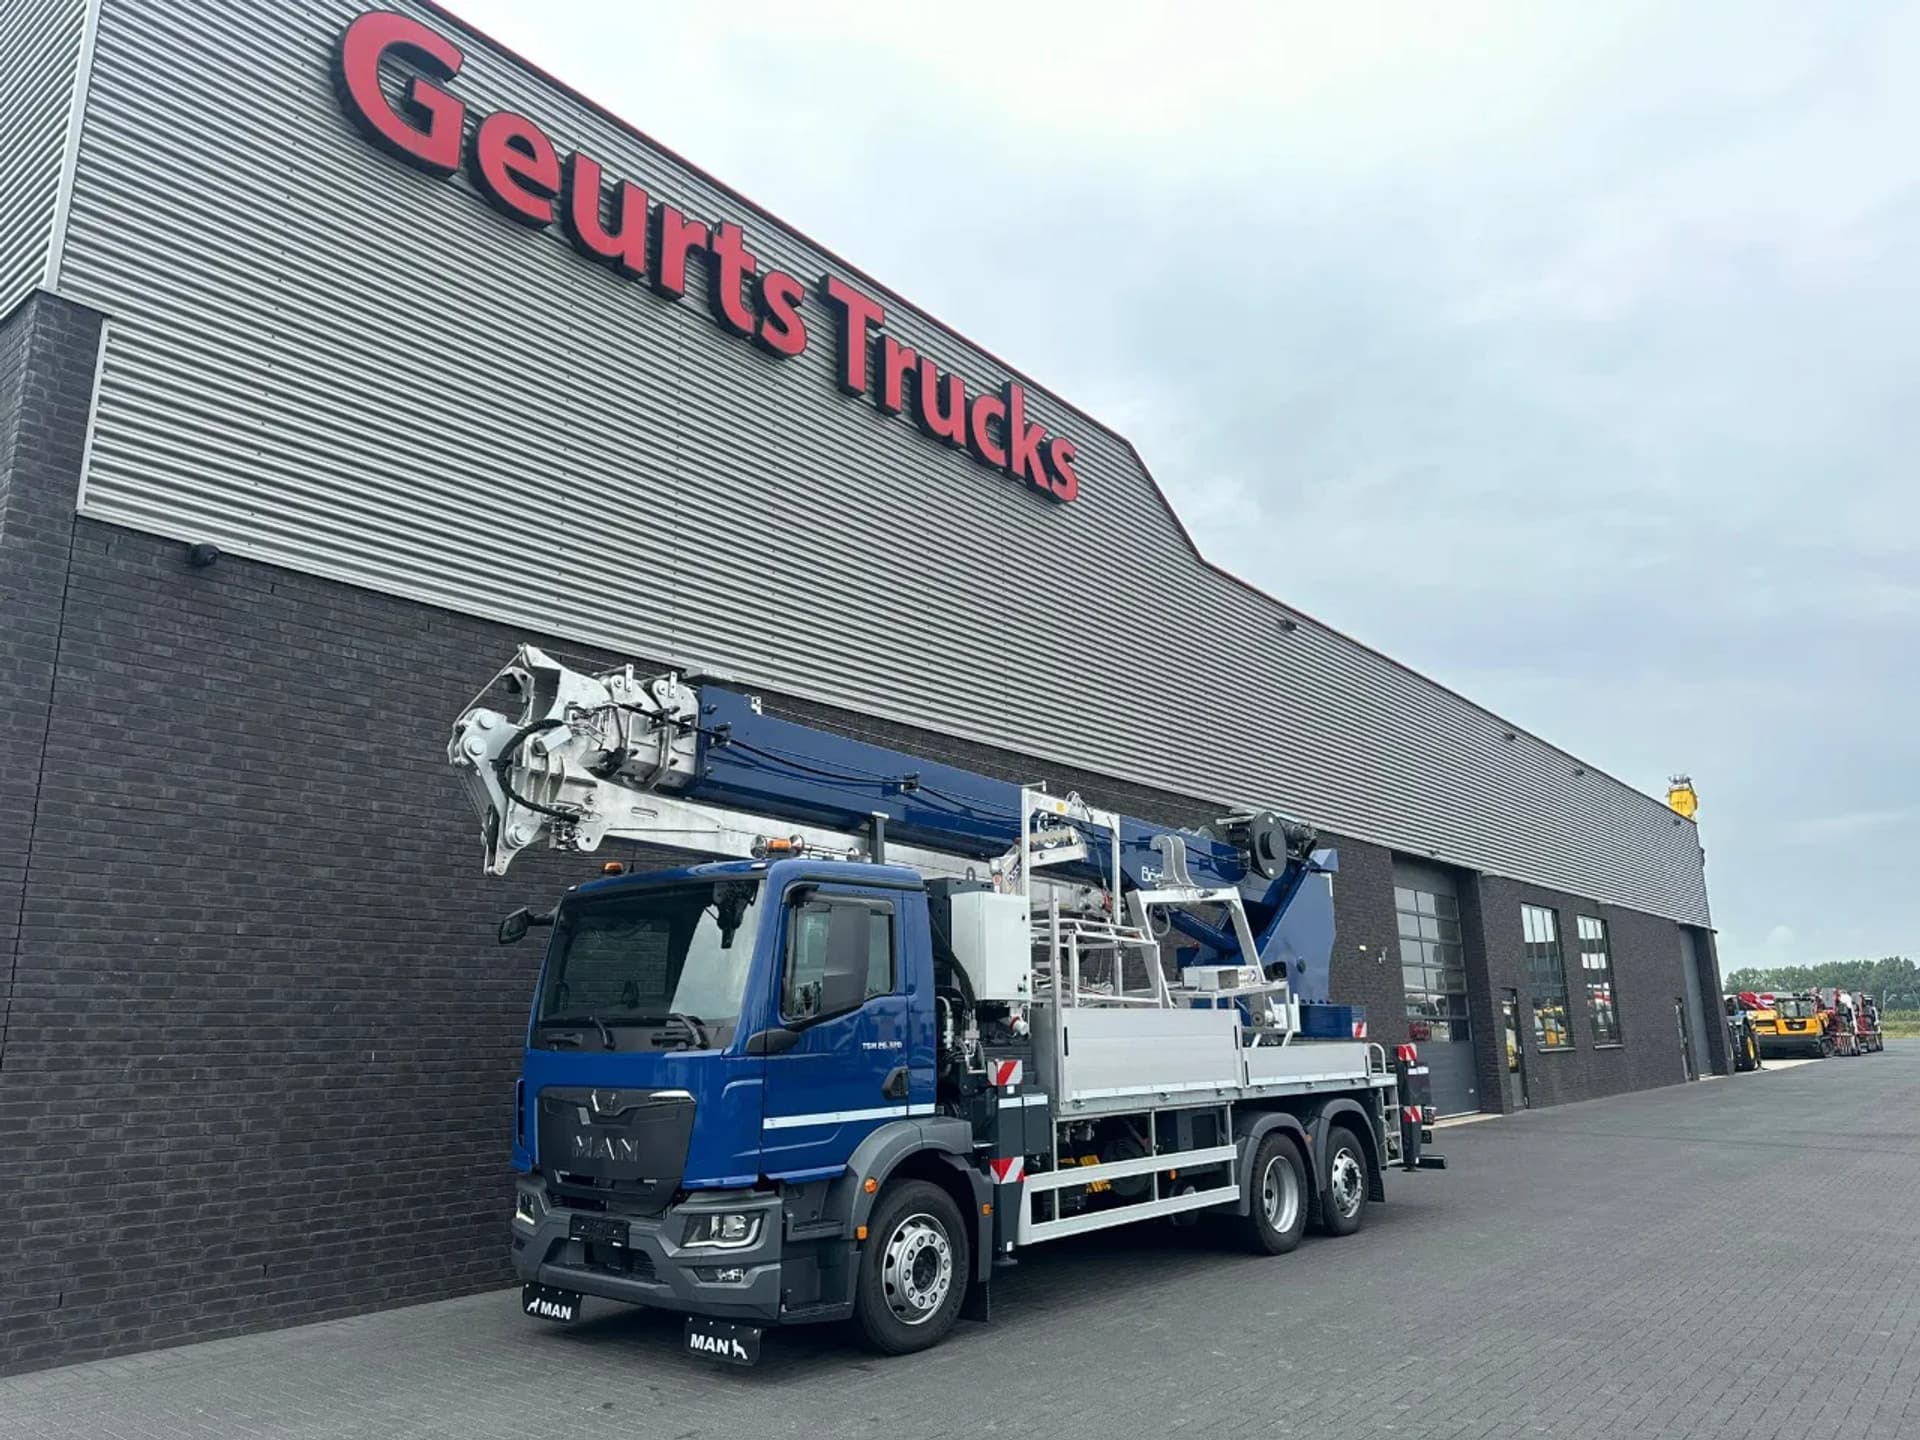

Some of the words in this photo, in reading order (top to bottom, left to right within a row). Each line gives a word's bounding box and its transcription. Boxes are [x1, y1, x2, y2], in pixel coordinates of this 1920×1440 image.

[340, 10, 808, 357] Geurts
[826, 276, 1078, 503] Trucks
[573, 1135, 639, 1162] MAN
[540, 1301, 572, 1320] MAN
[690, 1333, 729, 1355] MAN
